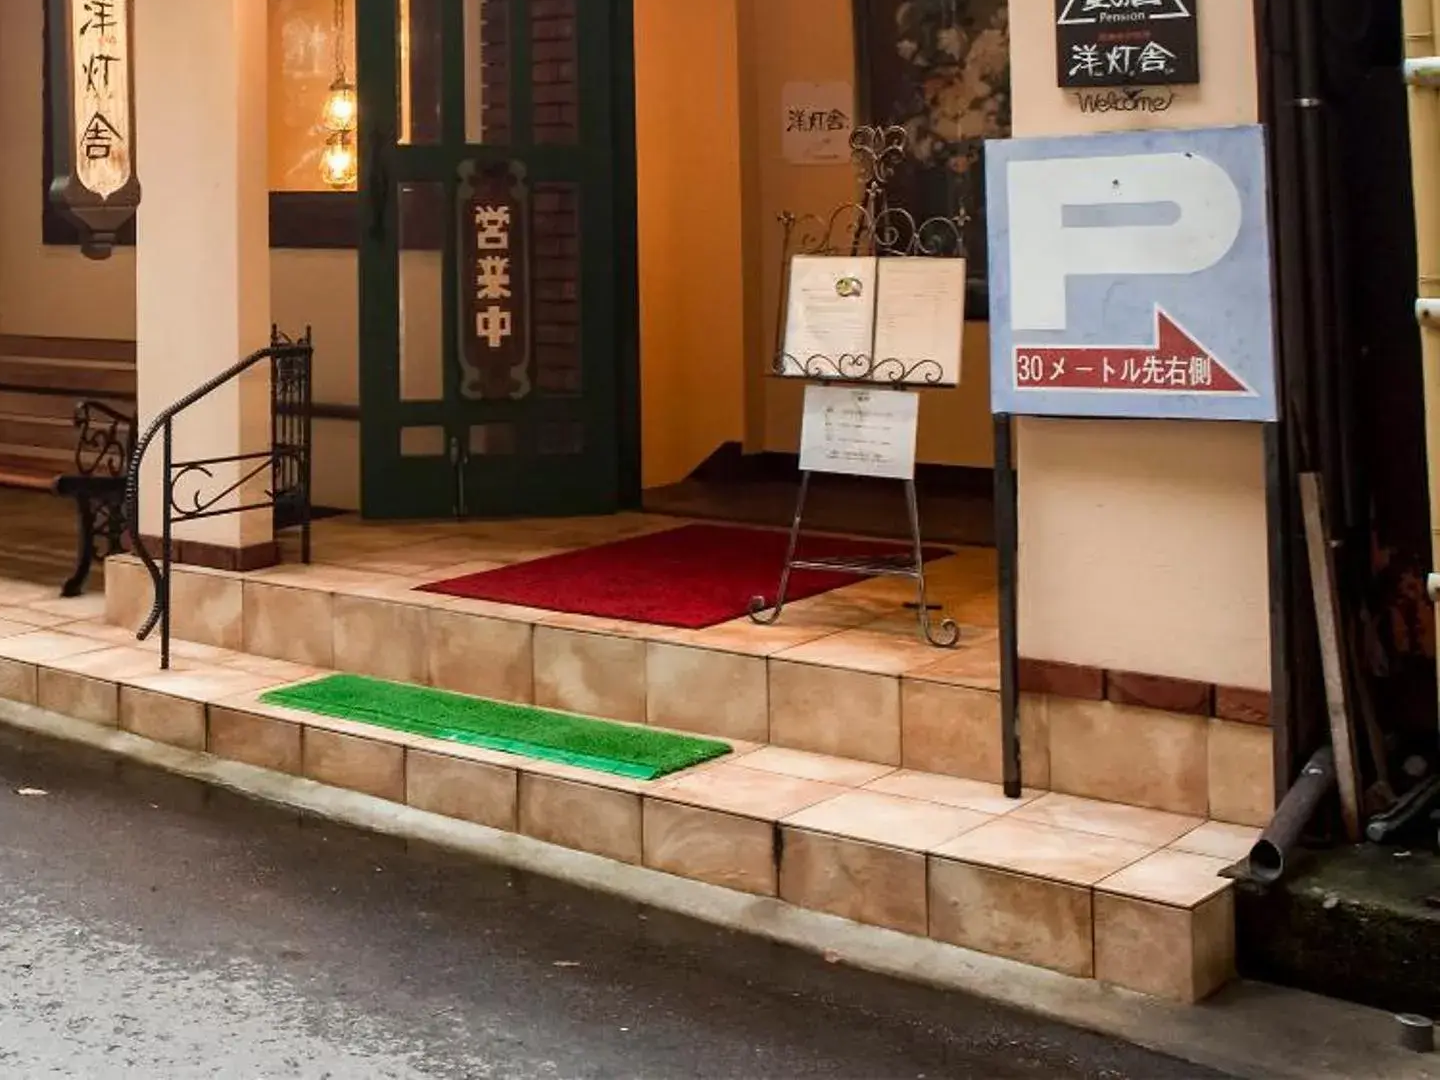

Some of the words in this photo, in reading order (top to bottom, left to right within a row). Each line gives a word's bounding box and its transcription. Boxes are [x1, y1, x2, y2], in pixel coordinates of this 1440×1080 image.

[1099, 11, 1145, 23] Pension
[1069, 41, 1177, 77] 洋灯舎
[1073, 90, 1174, 113] Welcome
[1006, 151, 1242, 331] P
[475, 205, 512, 348] 営業中
[1016, 354, 1212, 386] 30メートル先右側
